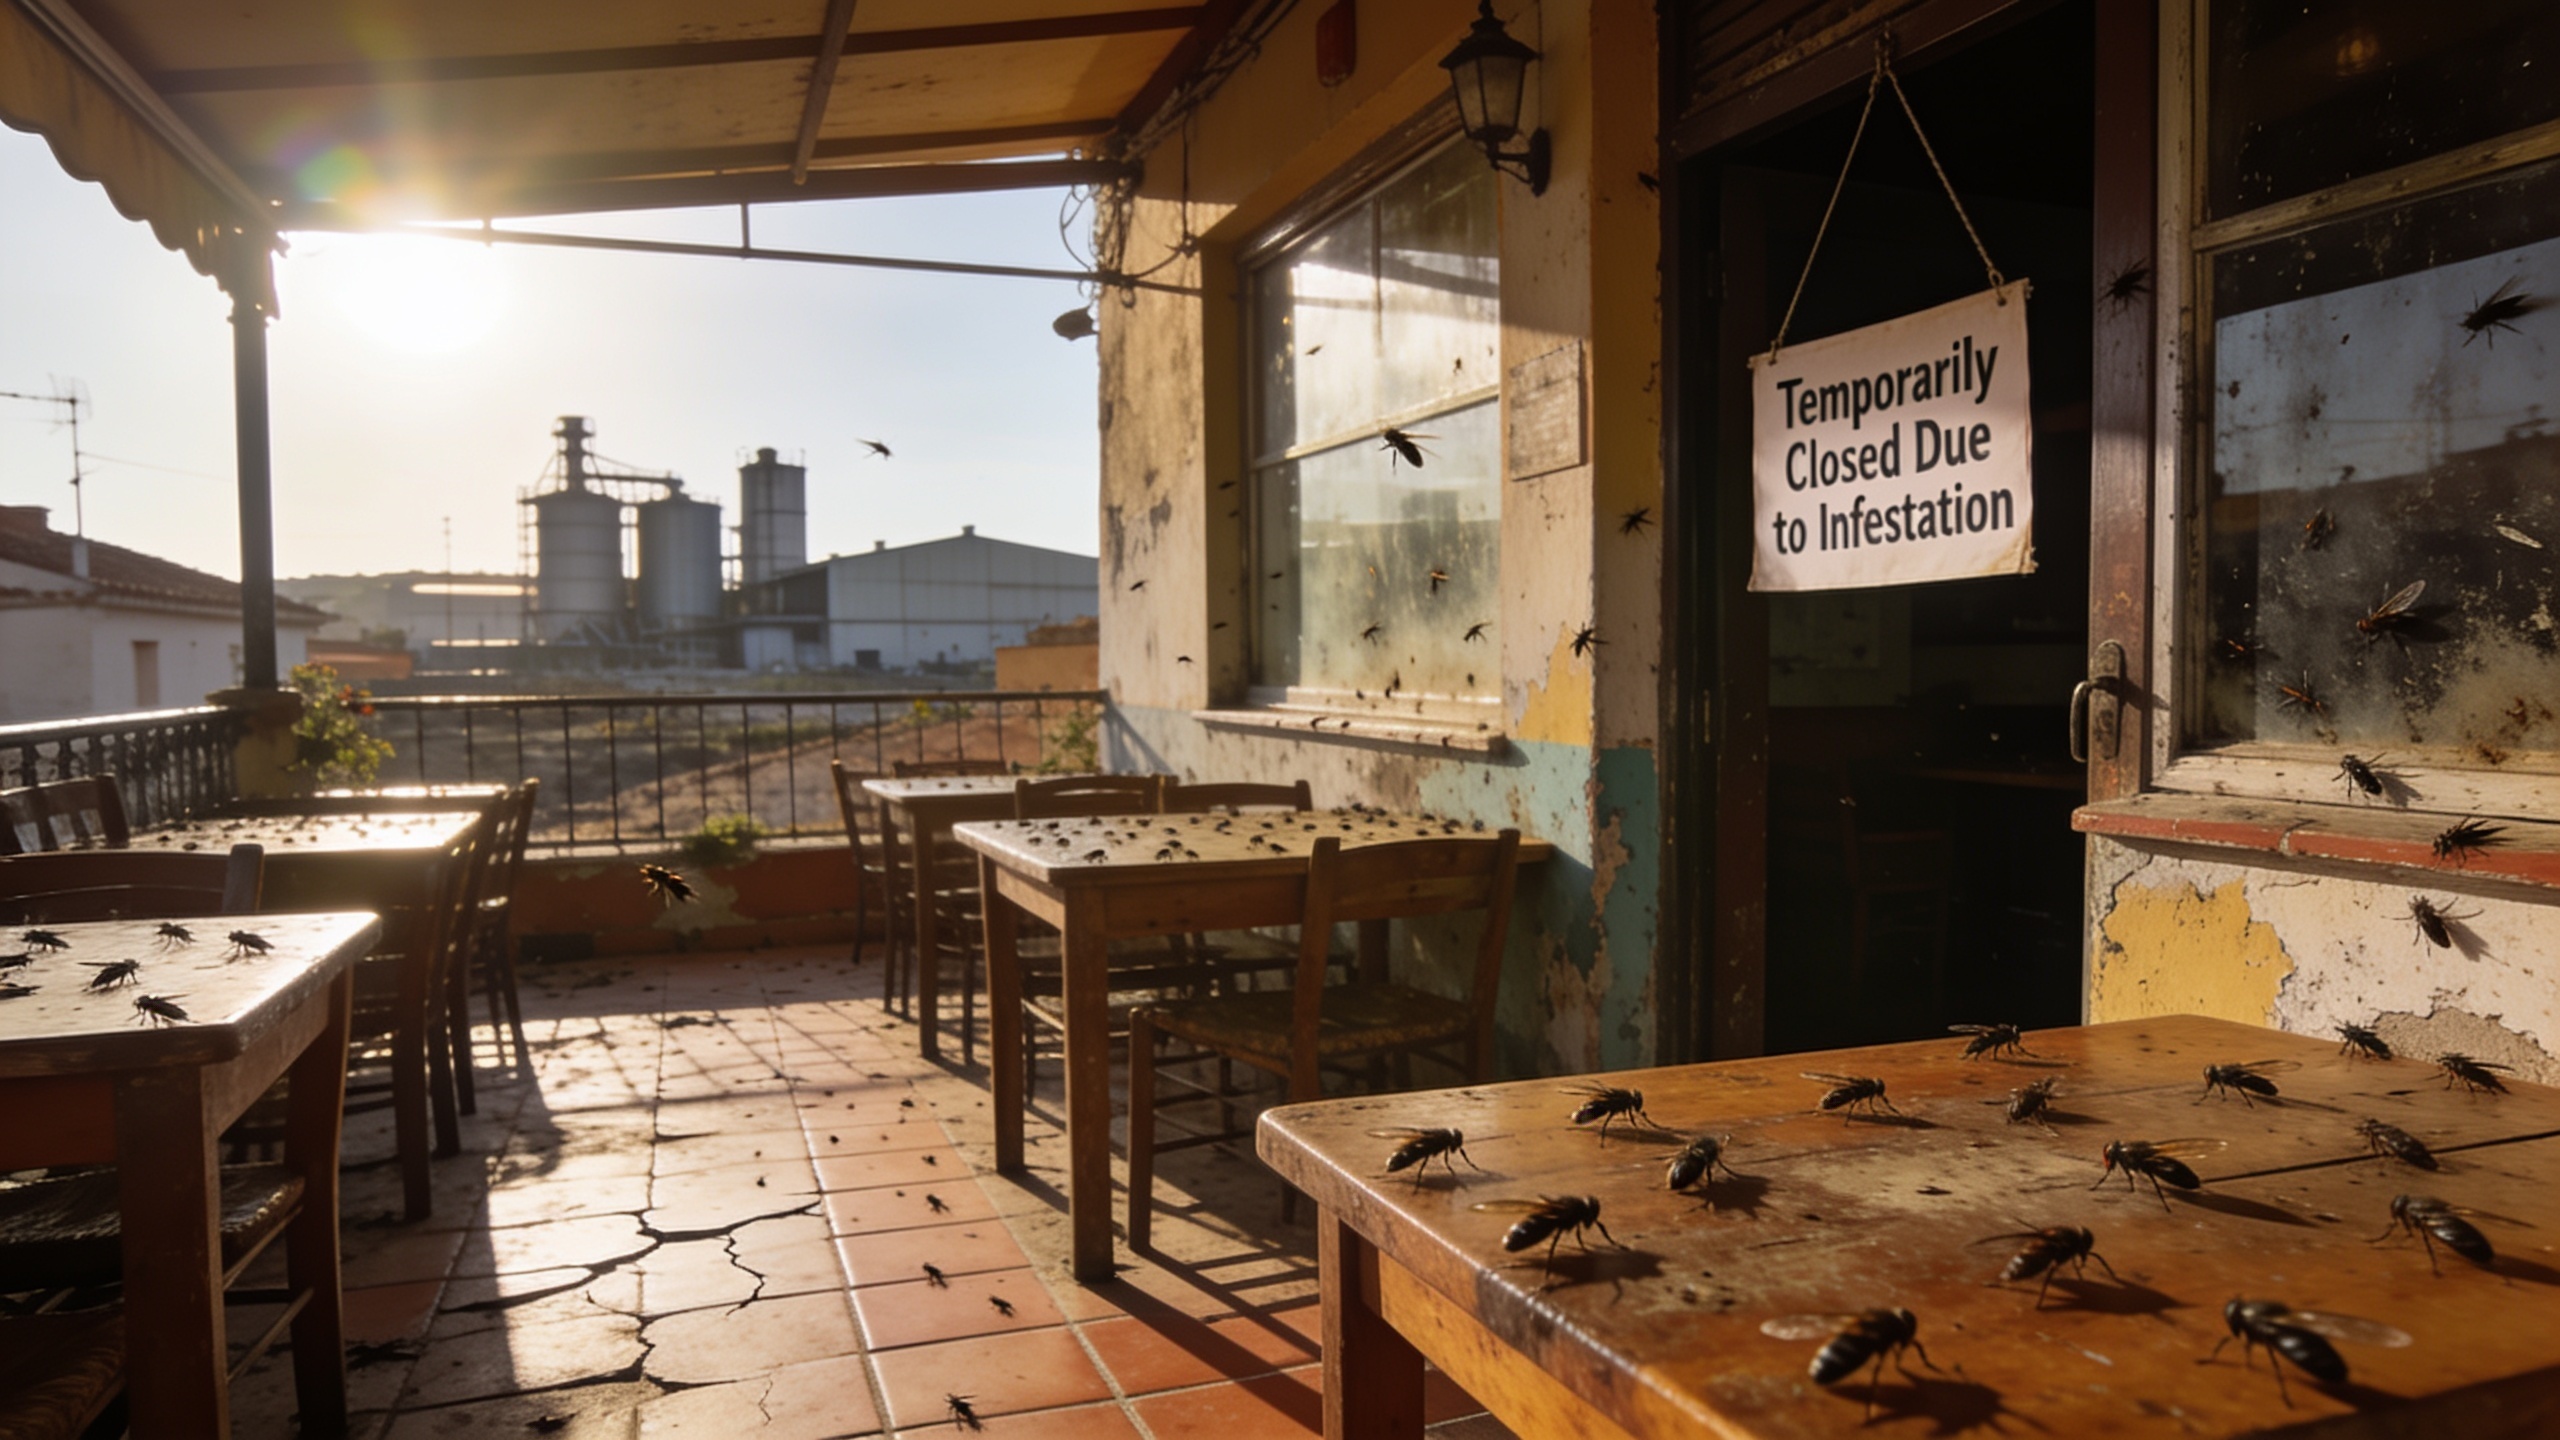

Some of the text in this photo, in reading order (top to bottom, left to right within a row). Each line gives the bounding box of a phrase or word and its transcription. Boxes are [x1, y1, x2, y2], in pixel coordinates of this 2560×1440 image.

[1777, 335, 1998, 430] Temporarily
[1786, 419, 1991, 492] Closed Due
[1772, 482, 2014, 554] to Infestation
